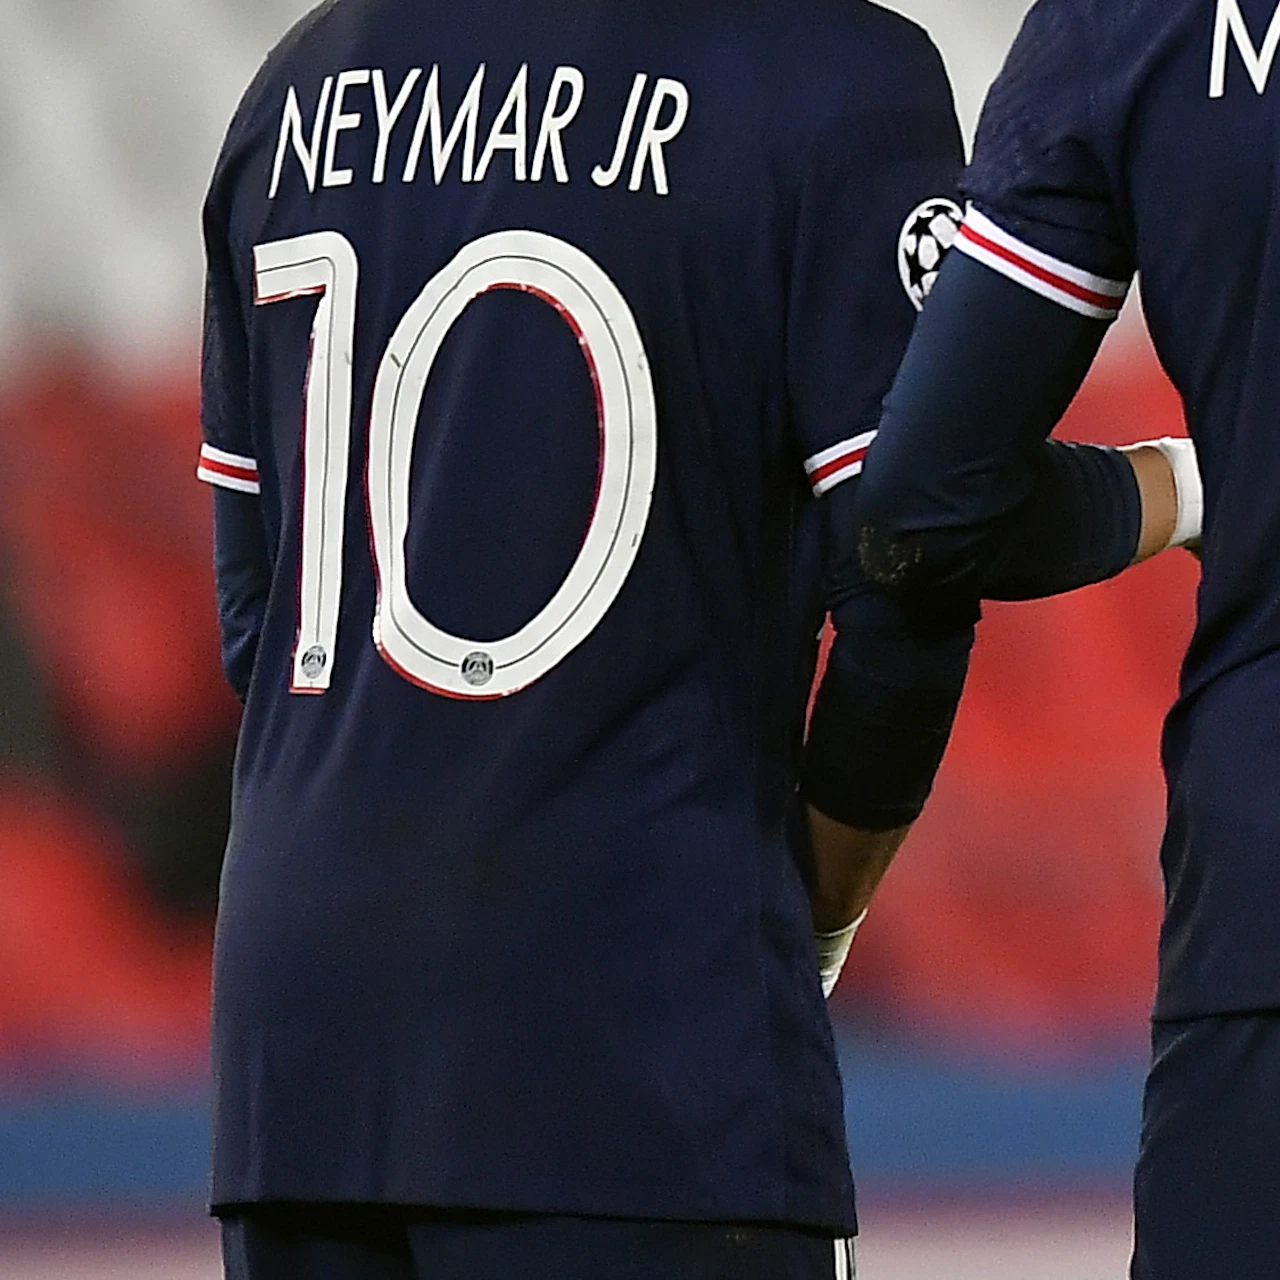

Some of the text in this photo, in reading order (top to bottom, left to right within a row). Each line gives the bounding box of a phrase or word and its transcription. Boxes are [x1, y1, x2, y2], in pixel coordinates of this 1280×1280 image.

[268, 63, 688, 199] NEYMAR JR
[253, 229, 657, 700] 10
